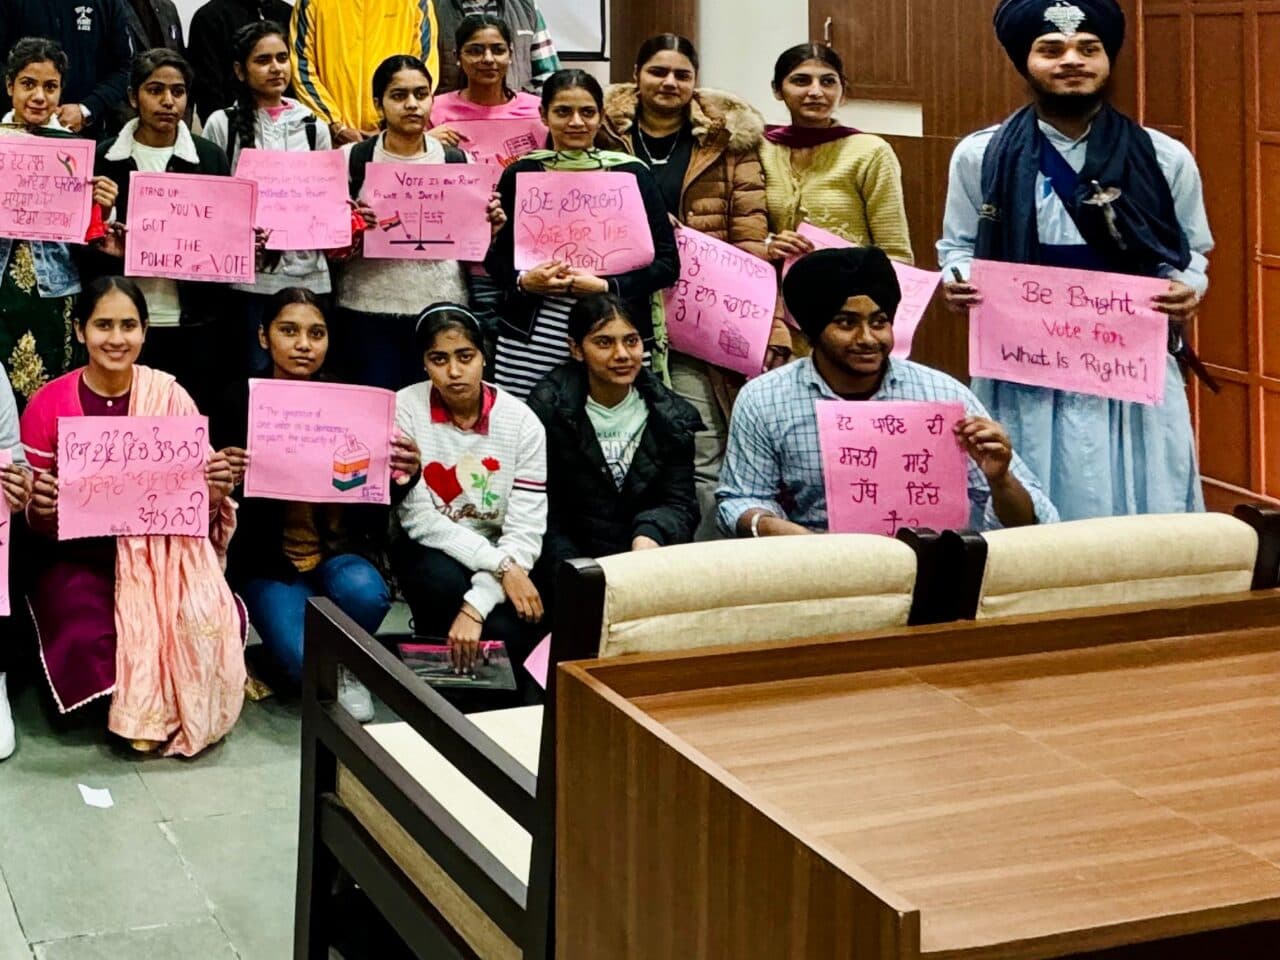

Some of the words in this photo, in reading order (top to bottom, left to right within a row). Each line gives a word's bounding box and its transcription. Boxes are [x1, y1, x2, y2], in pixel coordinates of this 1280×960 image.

[142, 219, 167, 233] GOT
[175, 238, 202, 252] THE
[140, 251, 183, 267] POWER
[209, 255, 249, 275] VOTE
[1068, 285, 1135, 315] Bright
[1001, 344, 1050, 366] What
